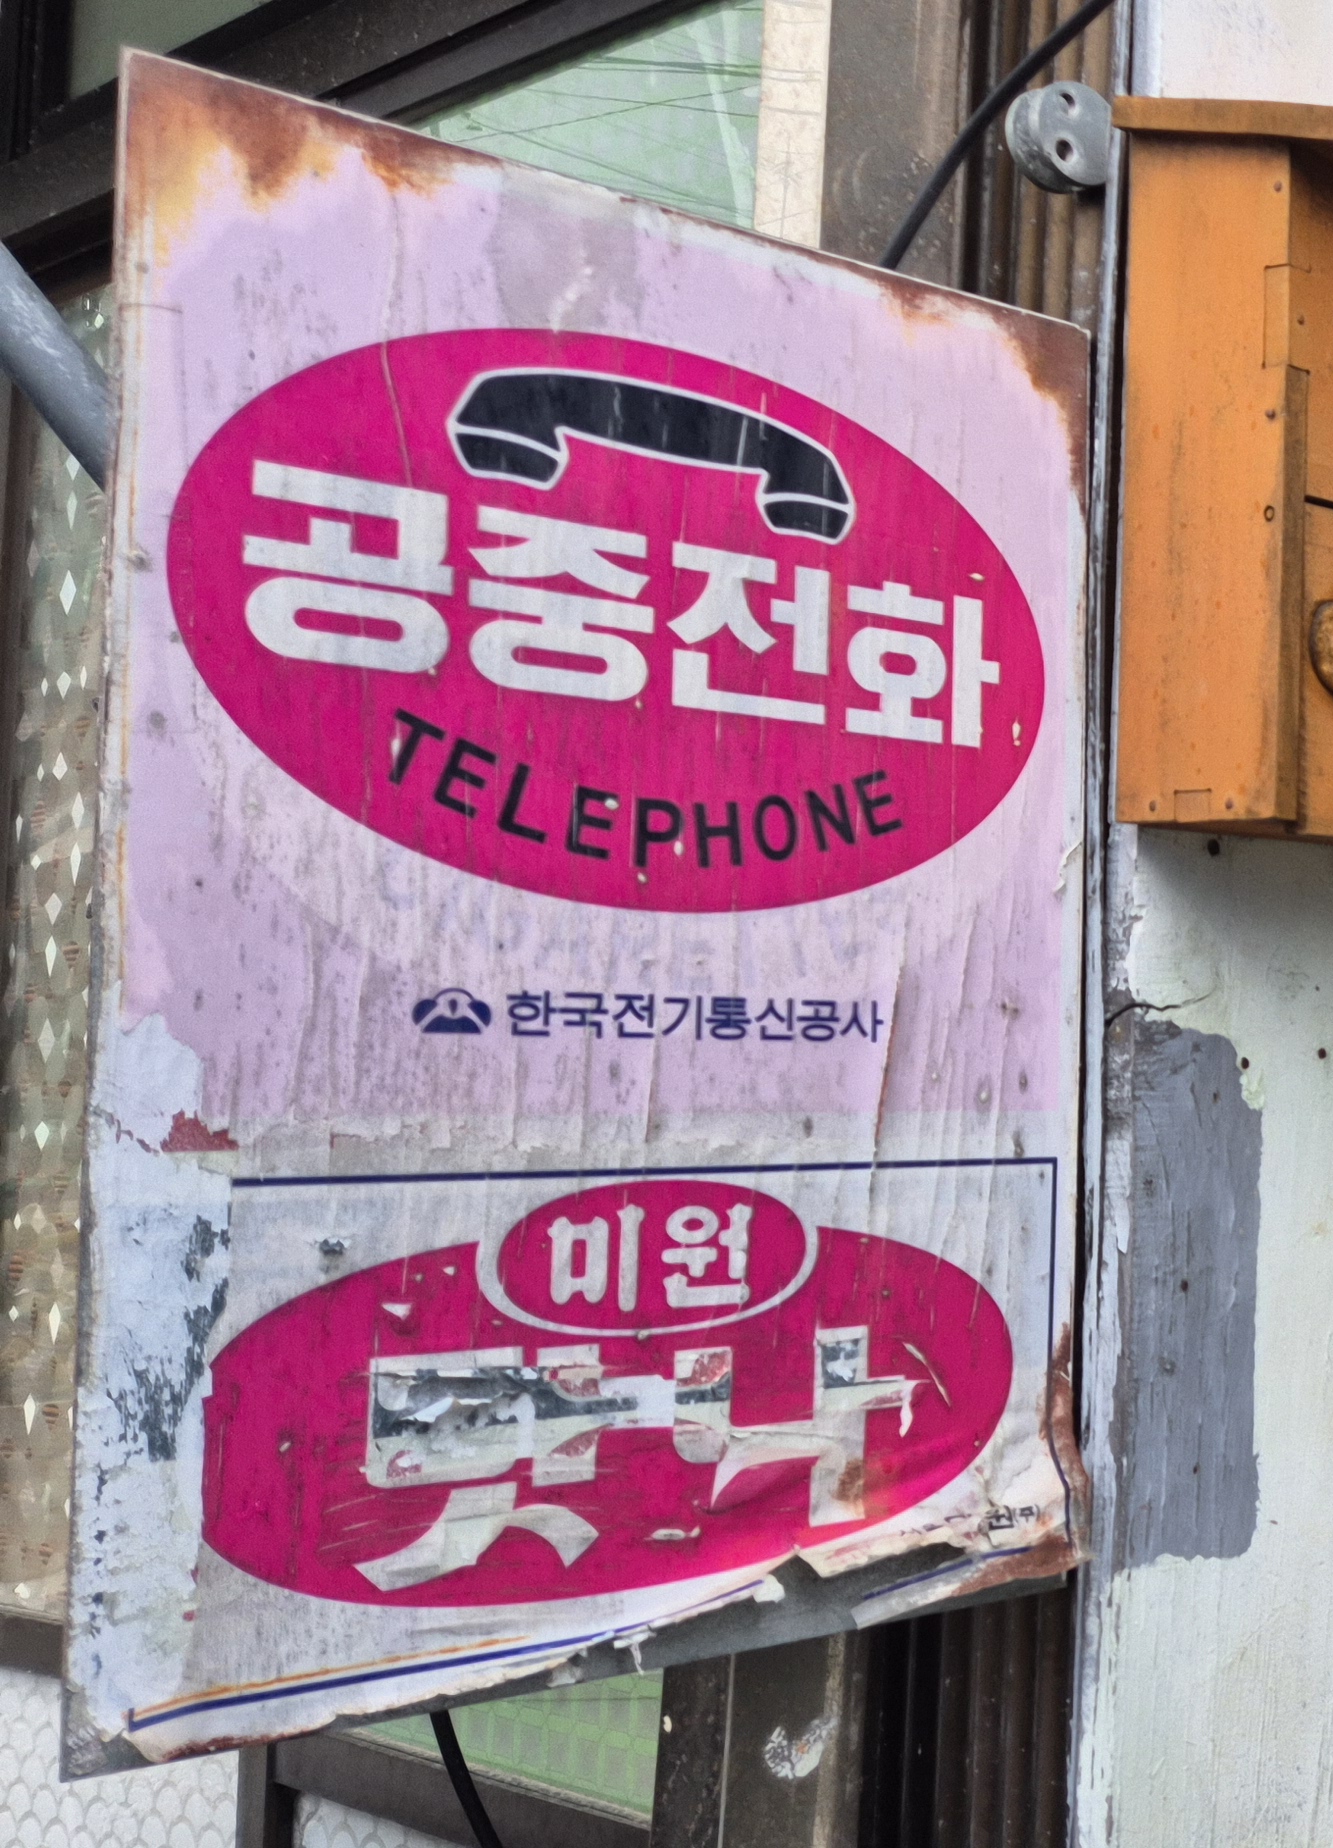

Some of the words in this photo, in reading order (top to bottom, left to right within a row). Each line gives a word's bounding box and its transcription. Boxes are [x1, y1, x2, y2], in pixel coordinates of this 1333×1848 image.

[241, 459, 1001, 749] 공중전화
[385, 708, 904, 869] TELEPHONE
[506, 990, 885, 1044] 한국전기통신공사
[546, 1201, 755, 1312] 미원
